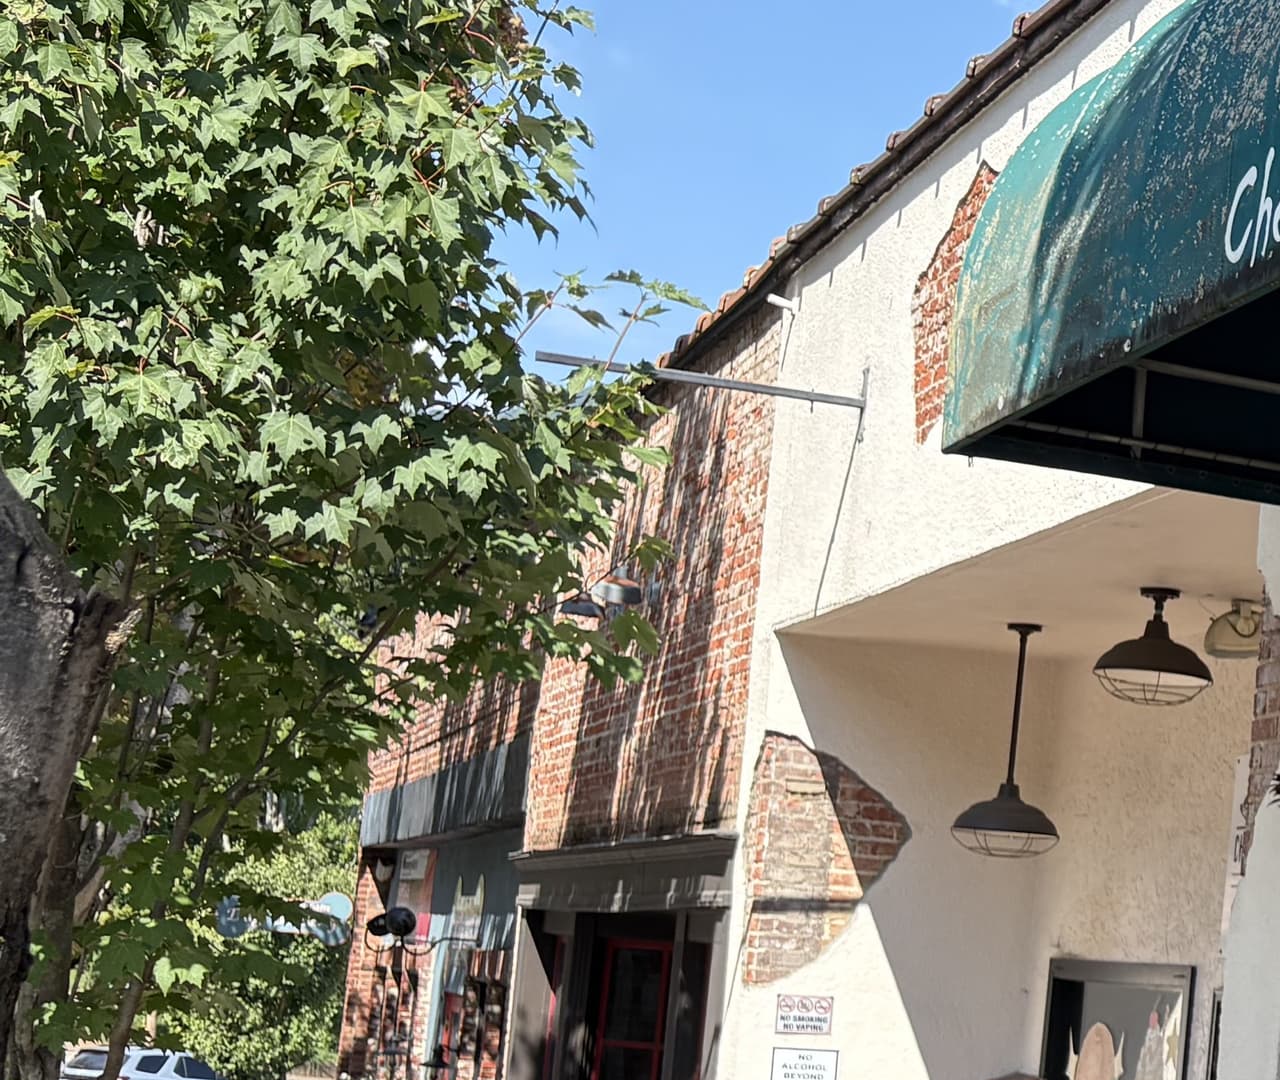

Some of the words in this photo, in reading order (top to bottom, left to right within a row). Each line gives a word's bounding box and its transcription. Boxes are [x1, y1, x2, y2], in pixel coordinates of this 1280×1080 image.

[780, 1014, 791, 1022] NO
[793, 1015, 828, 1023] SMOKING
[796, 1023, 824, 1032] VAPING
[782, 1063, 828, 1071] ALCOHOL
[783, 1072, 824, 1080] BEYOND
